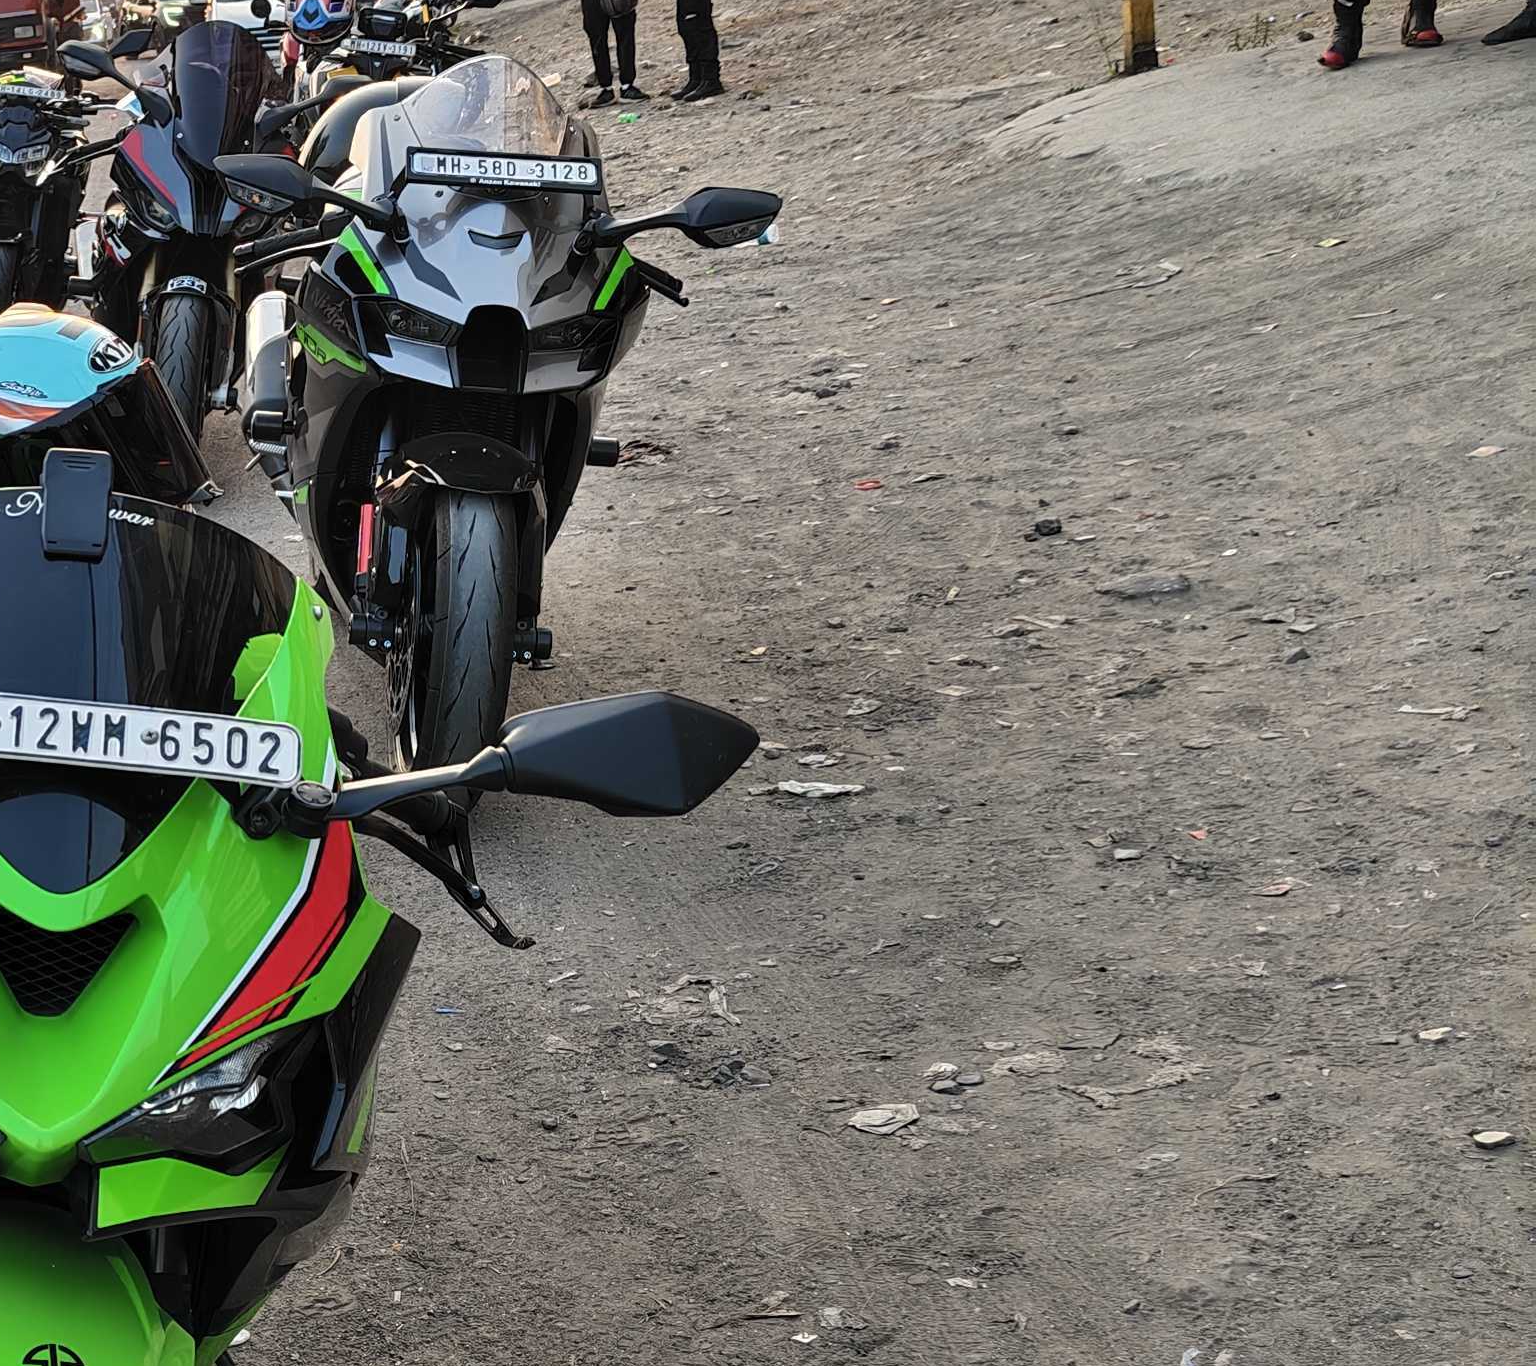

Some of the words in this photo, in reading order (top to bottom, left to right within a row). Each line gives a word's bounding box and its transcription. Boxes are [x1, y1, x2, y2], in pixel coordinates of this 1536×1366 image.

[437, 156, 461, 175] MH
[477, 159, 517, 178] 58D
[534, 161, 590, 181] 3128
[503, 179, 542, 188] Kawasaki
[89, 337, 133, 372] KYT
[10, 706, 126, 759] 12WM
[159, 720, 282, 776] 6502
